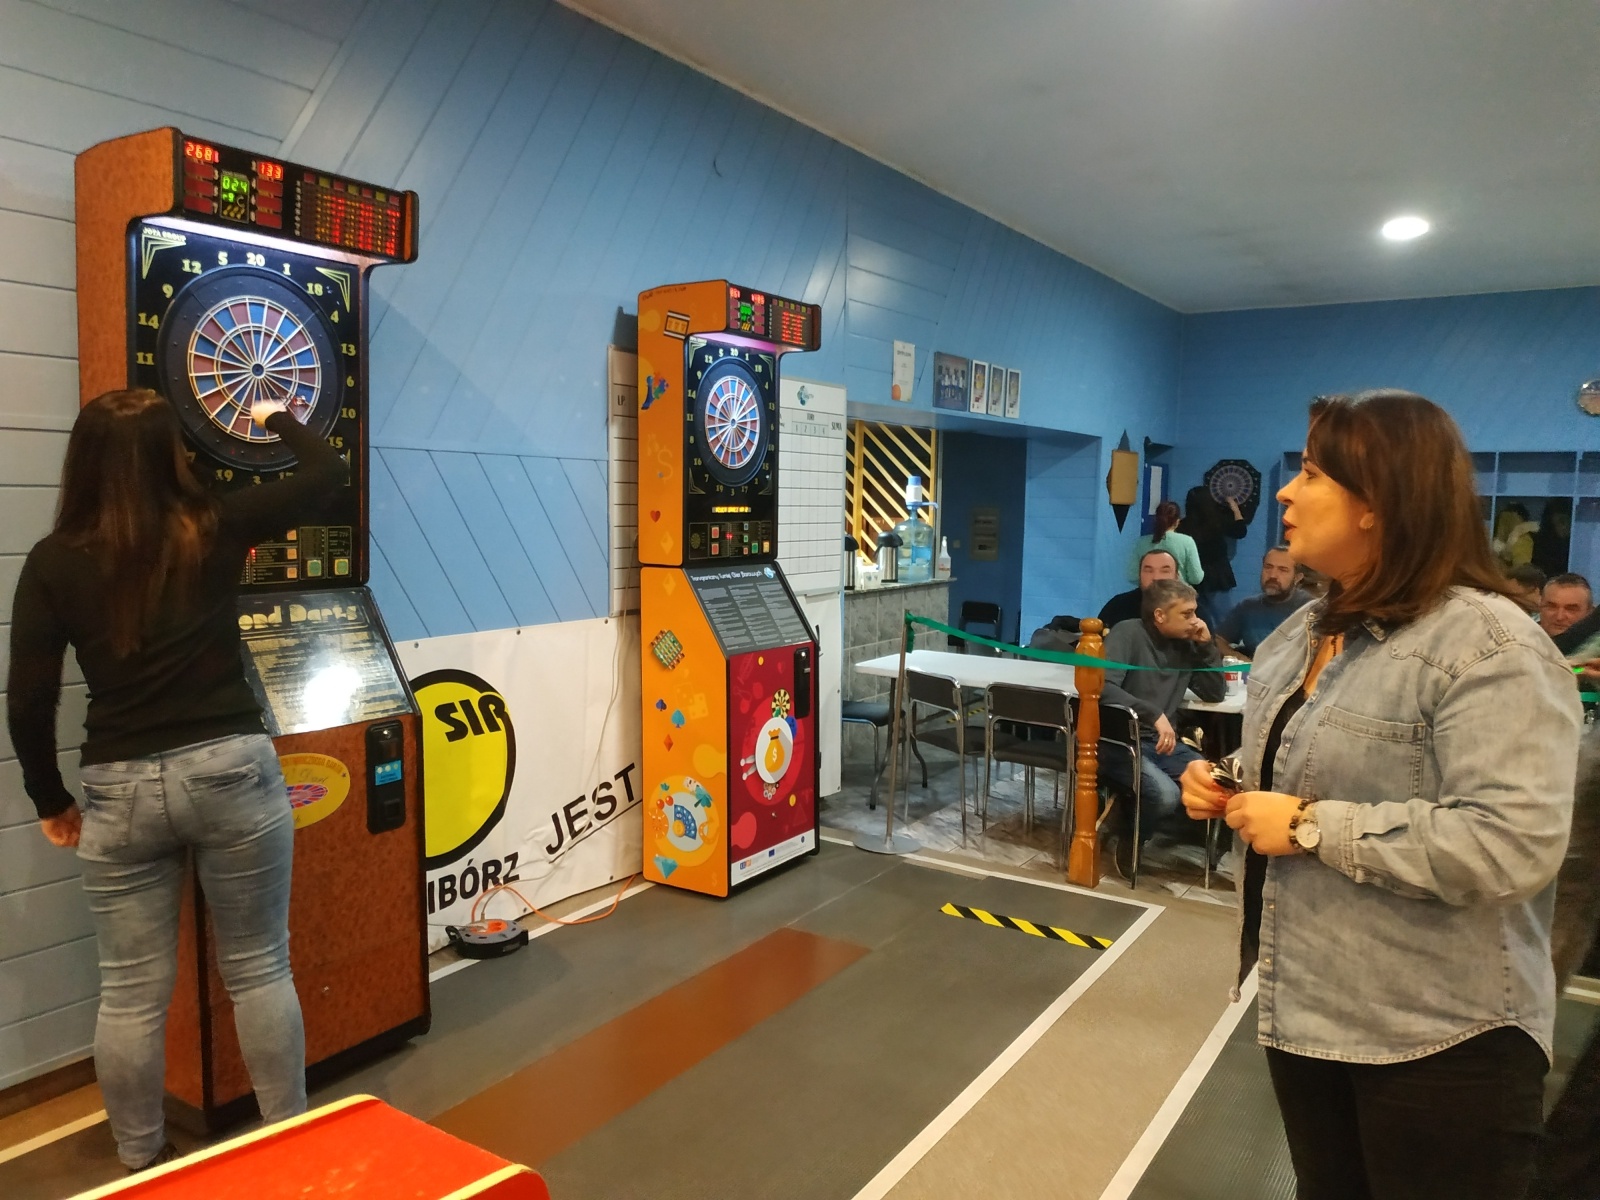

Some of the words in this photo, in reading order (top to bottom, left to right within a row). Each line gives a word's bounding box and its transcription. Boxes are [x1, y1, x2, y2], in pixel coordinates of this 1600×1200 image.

[261, 162, 282, 179] 133
[217, 251, 228, 266] 5
[247, 252, 266, 267] 20
[182, 259, 202, 275] 12
[282, 263, 292, 276] 1
[162, 284, 174, 299] 9
[307, 282, 323, 296] 18
[138, 312, 160, 329] 14
[330, 310, 340, 323] 4
[341, 343, 356, 357] 13
[730, 348, 739, 357] 20
[136, 352, 154, 366] 11
[704, 354, 713, 364] 12
[346, 375, 355, 388] 6
[688, 389, 696, 399] 14
[341, 407, 356, 419] 10
[328, 437, 344, 449] 15
[215, 469, 234, 483] 19
[289, 603, 358, 623] Darts
[545, 762, 636, 856] JEST
[427, 852, 520, 915] IBÓRZ
